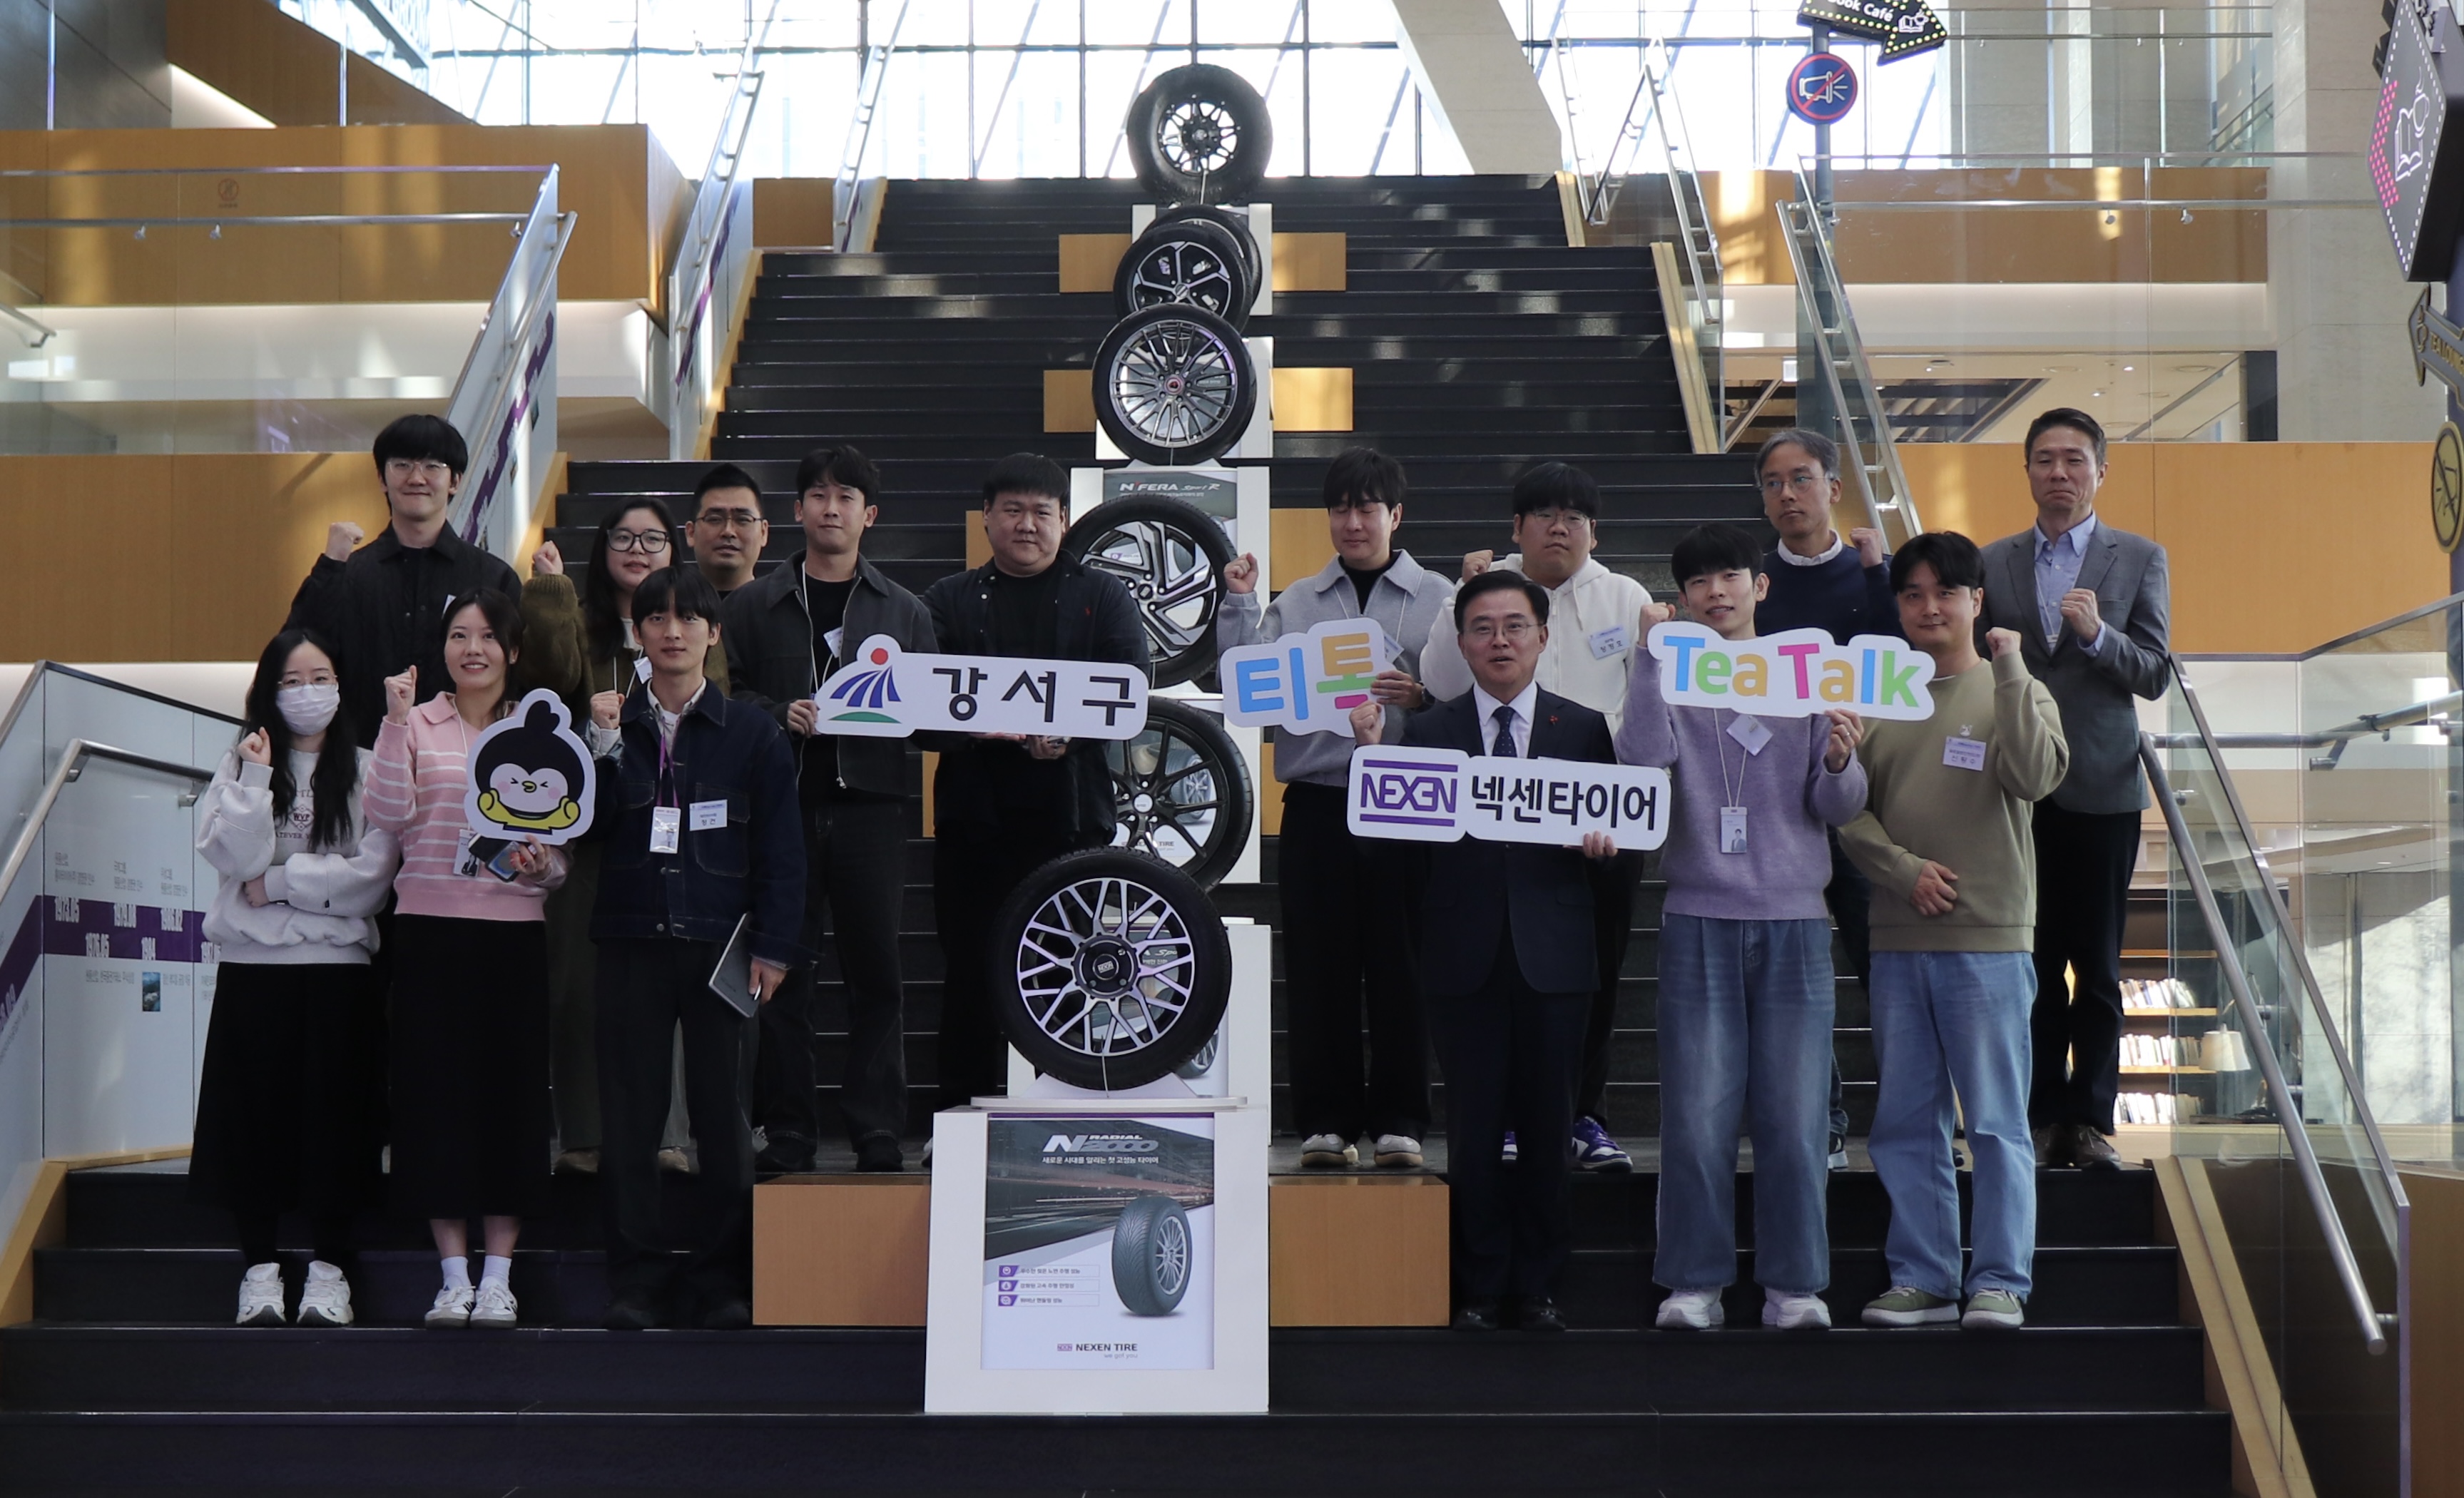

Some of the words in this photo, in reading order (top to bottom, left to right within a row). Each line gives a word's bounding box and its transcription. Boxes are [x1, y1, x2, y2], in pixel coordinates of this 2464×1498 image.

[1863, 3, 1894, 22] Café
[932, 666, 1136, 726] 강서구
[1663, 635, 1768, 697] Tea
[1778, 643, 1921, 708] Talk
[1360, 773, 1457, 813] NEXEN
[1471, 775, 1657, 831] 넥센타이어
